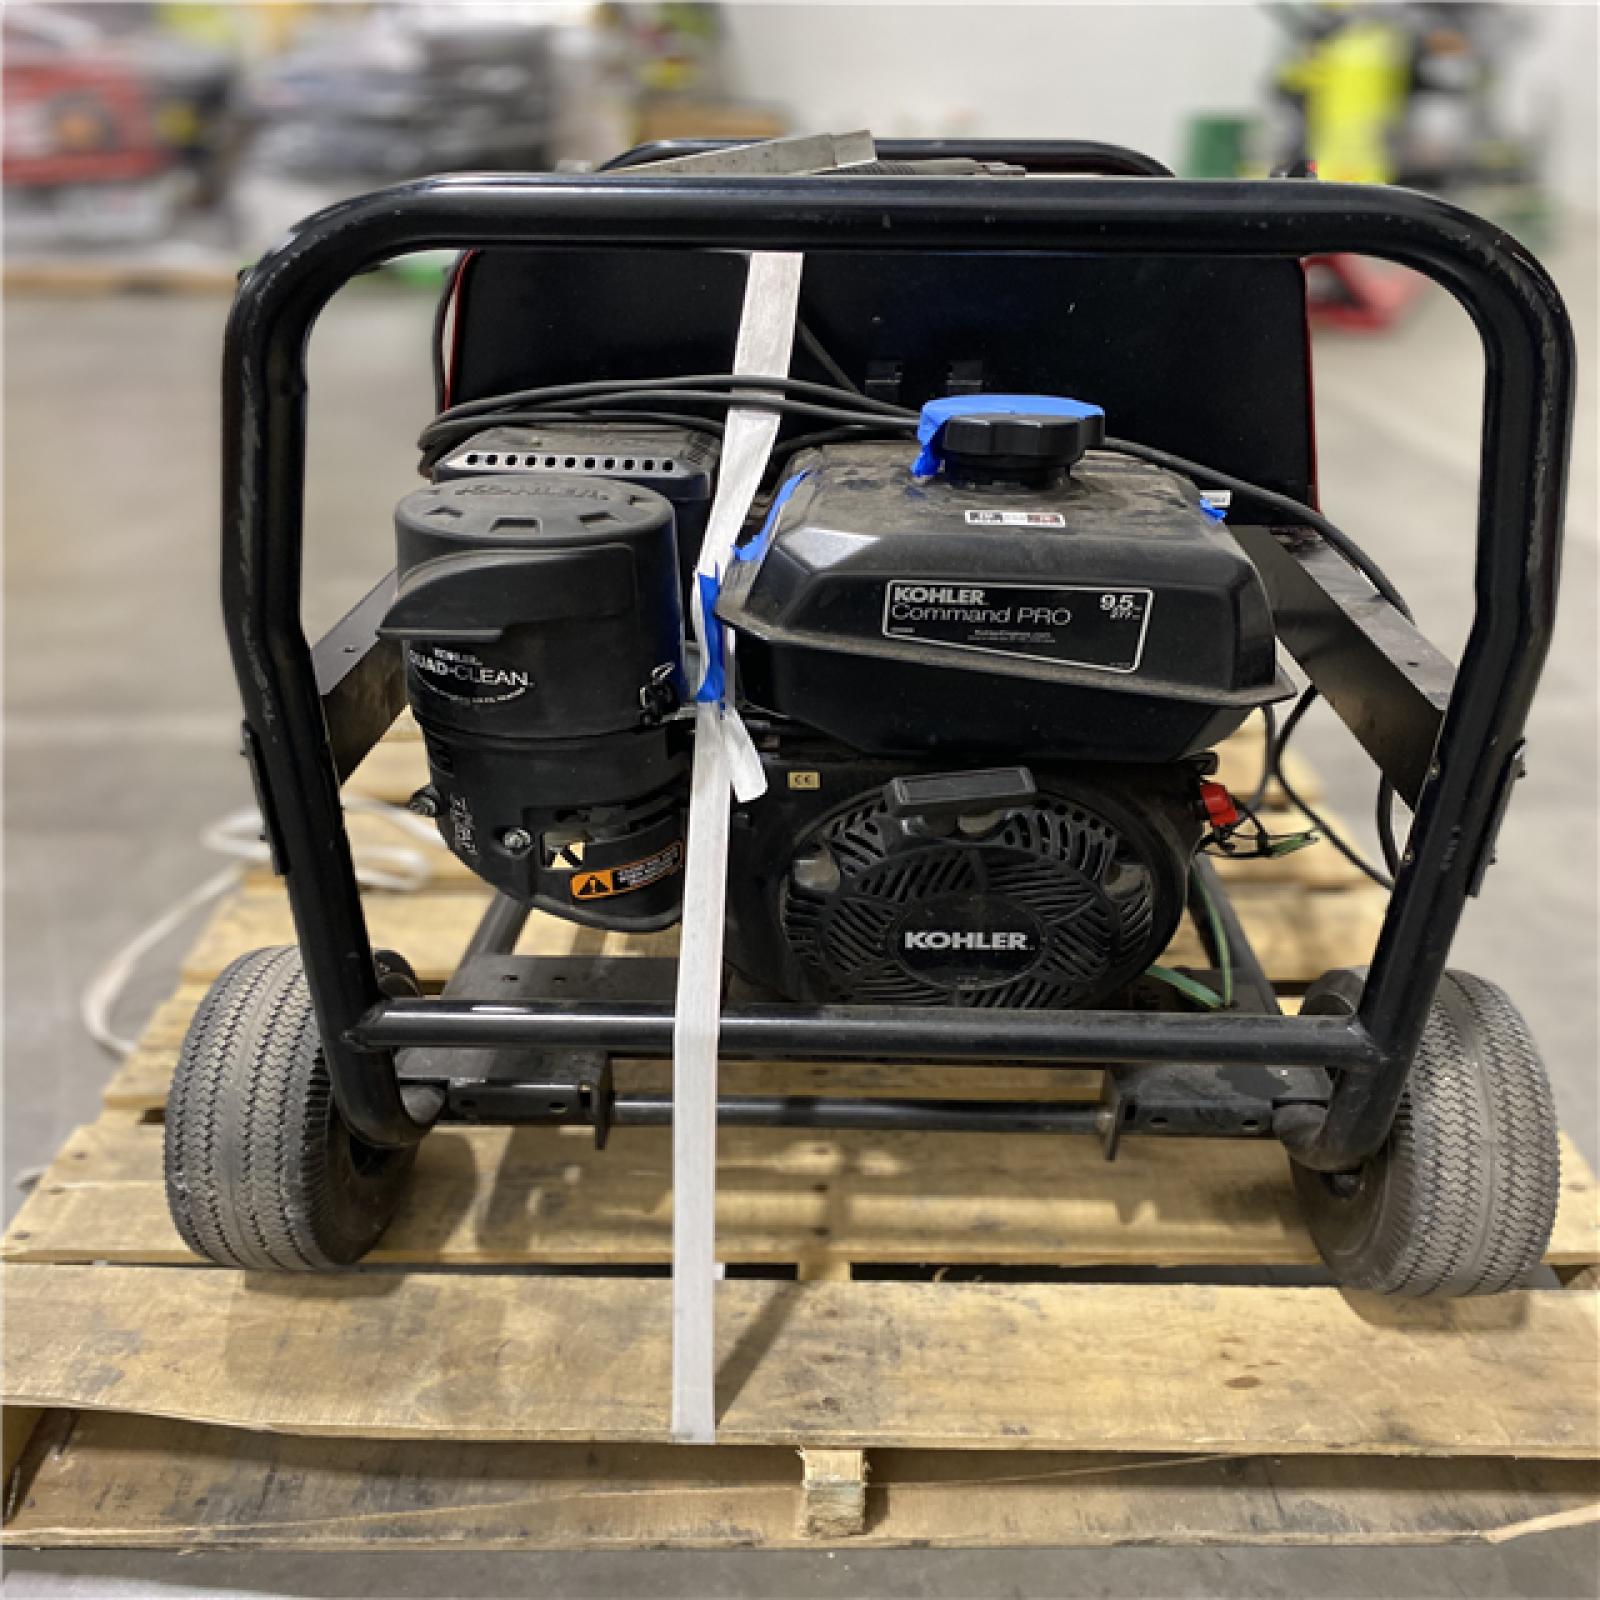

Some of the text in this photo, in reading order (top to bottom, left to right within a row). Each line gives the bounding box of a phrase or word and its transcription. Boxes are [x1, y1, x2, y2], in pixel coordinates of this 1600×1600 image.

[894, 586, 986, 605] KOHLER
[891, 603, 1073, 627] Command PRO
[904, 931, 1029, 951] KOHLER
